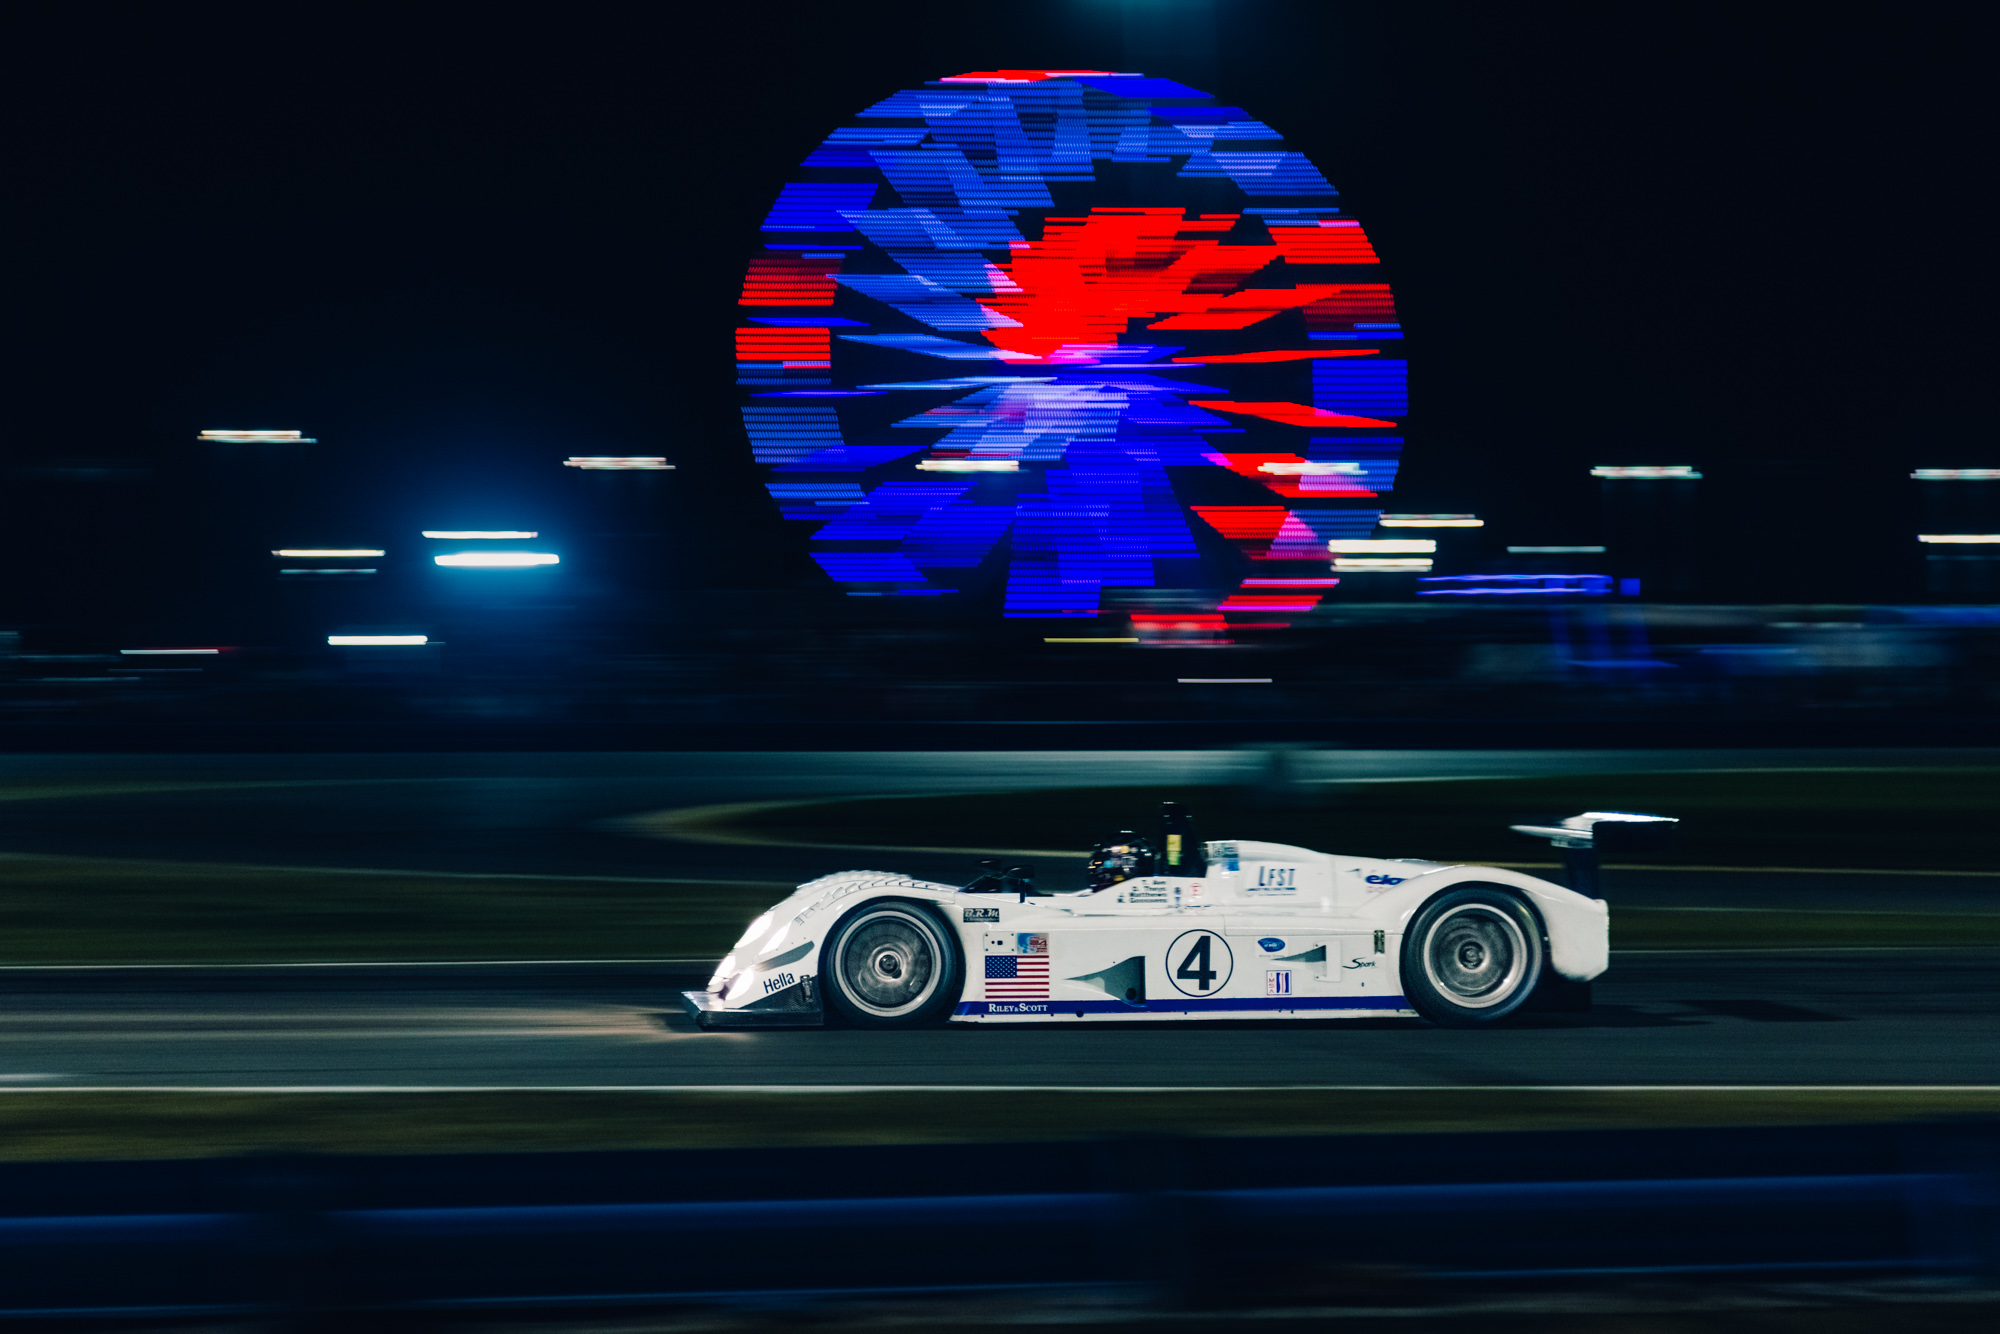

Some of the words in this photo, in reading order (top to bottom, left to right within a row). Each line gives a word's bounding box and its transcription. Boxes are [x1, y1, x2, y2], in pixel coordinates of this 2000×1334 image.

[1258, 866, 1295, 886] LFST
[1177, 935, 1217, 991] 4
[763, 972, 795, 994] Hella
